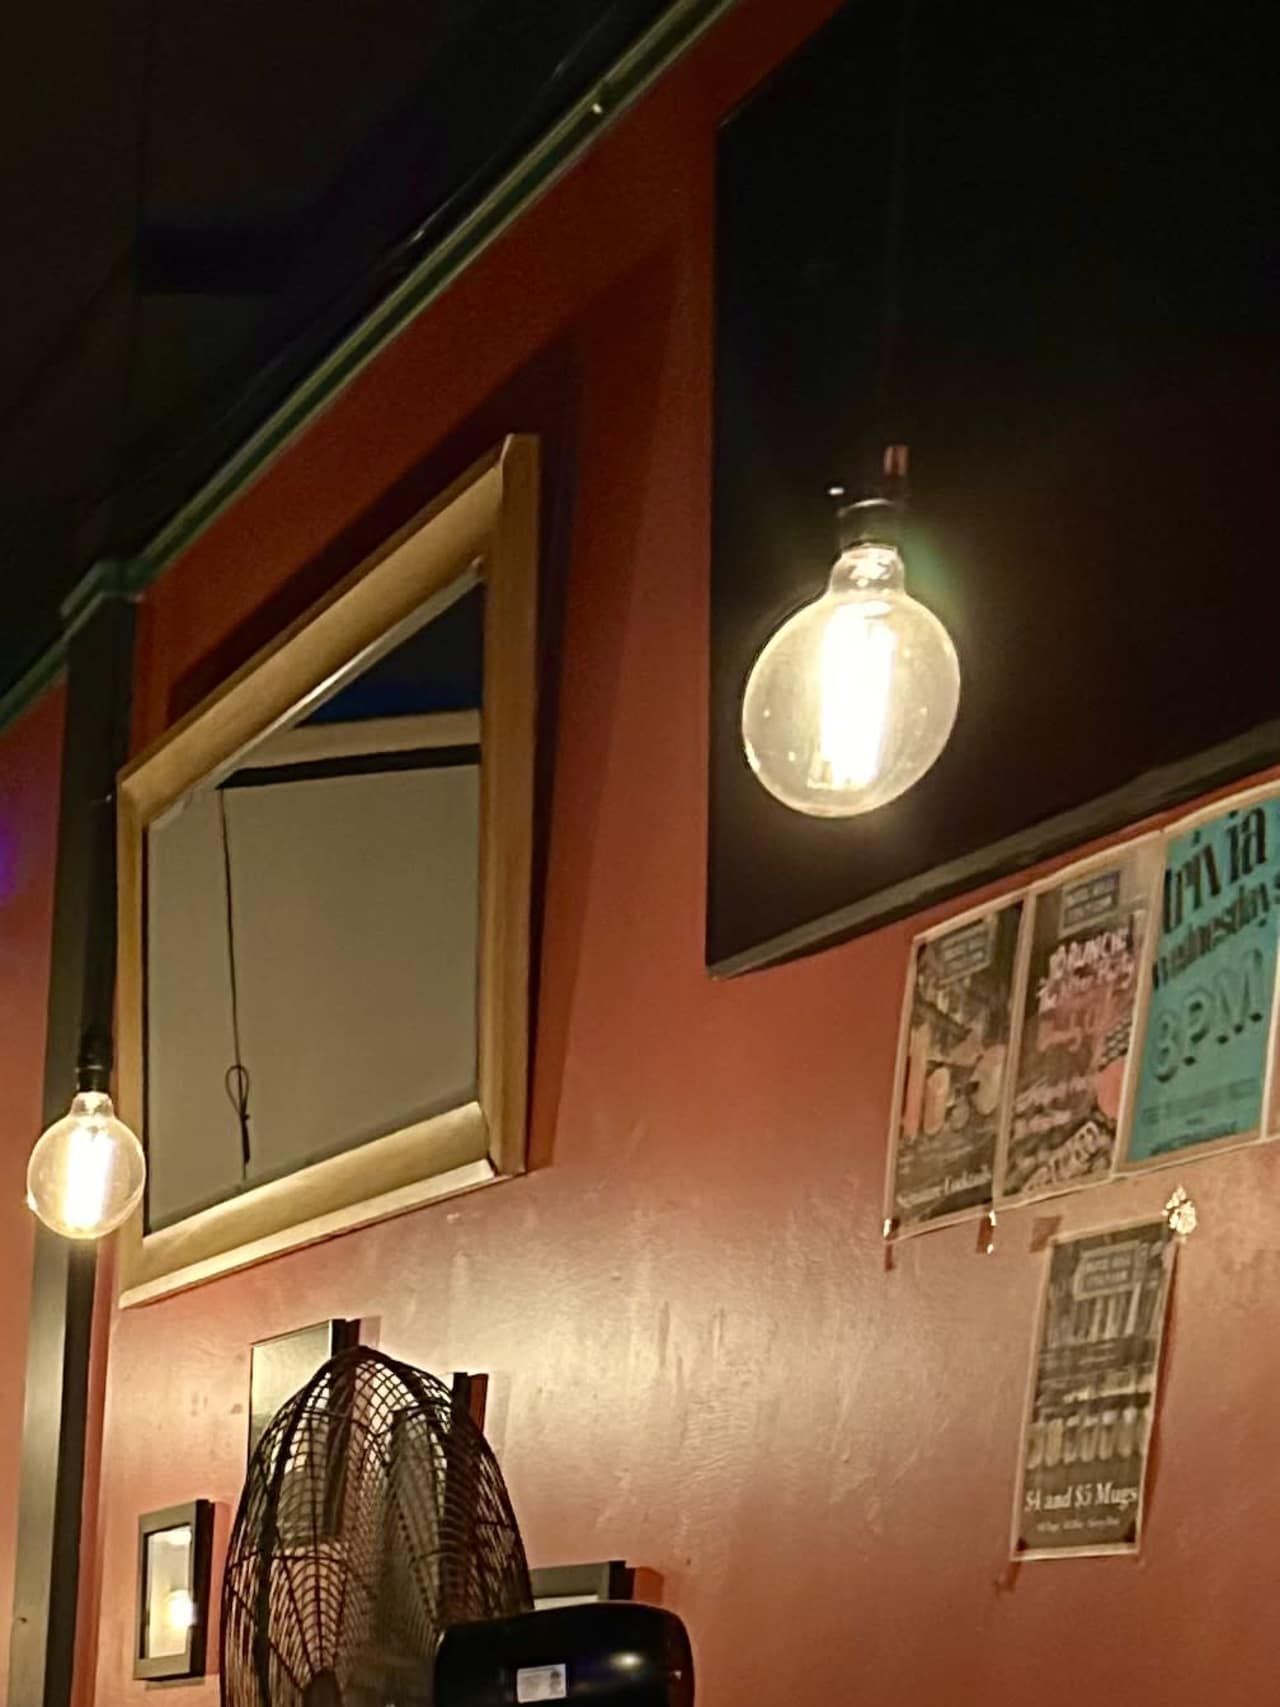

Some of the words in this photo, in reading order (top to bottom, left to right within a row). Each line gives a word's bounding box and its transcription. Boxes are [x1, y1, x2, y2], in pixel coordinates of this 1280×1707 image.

[1163, 806, 1267, 935] trivia
[1043, 1485, 1074, 1510] and
[1095, 1480, 1139, 1511] Mugs
